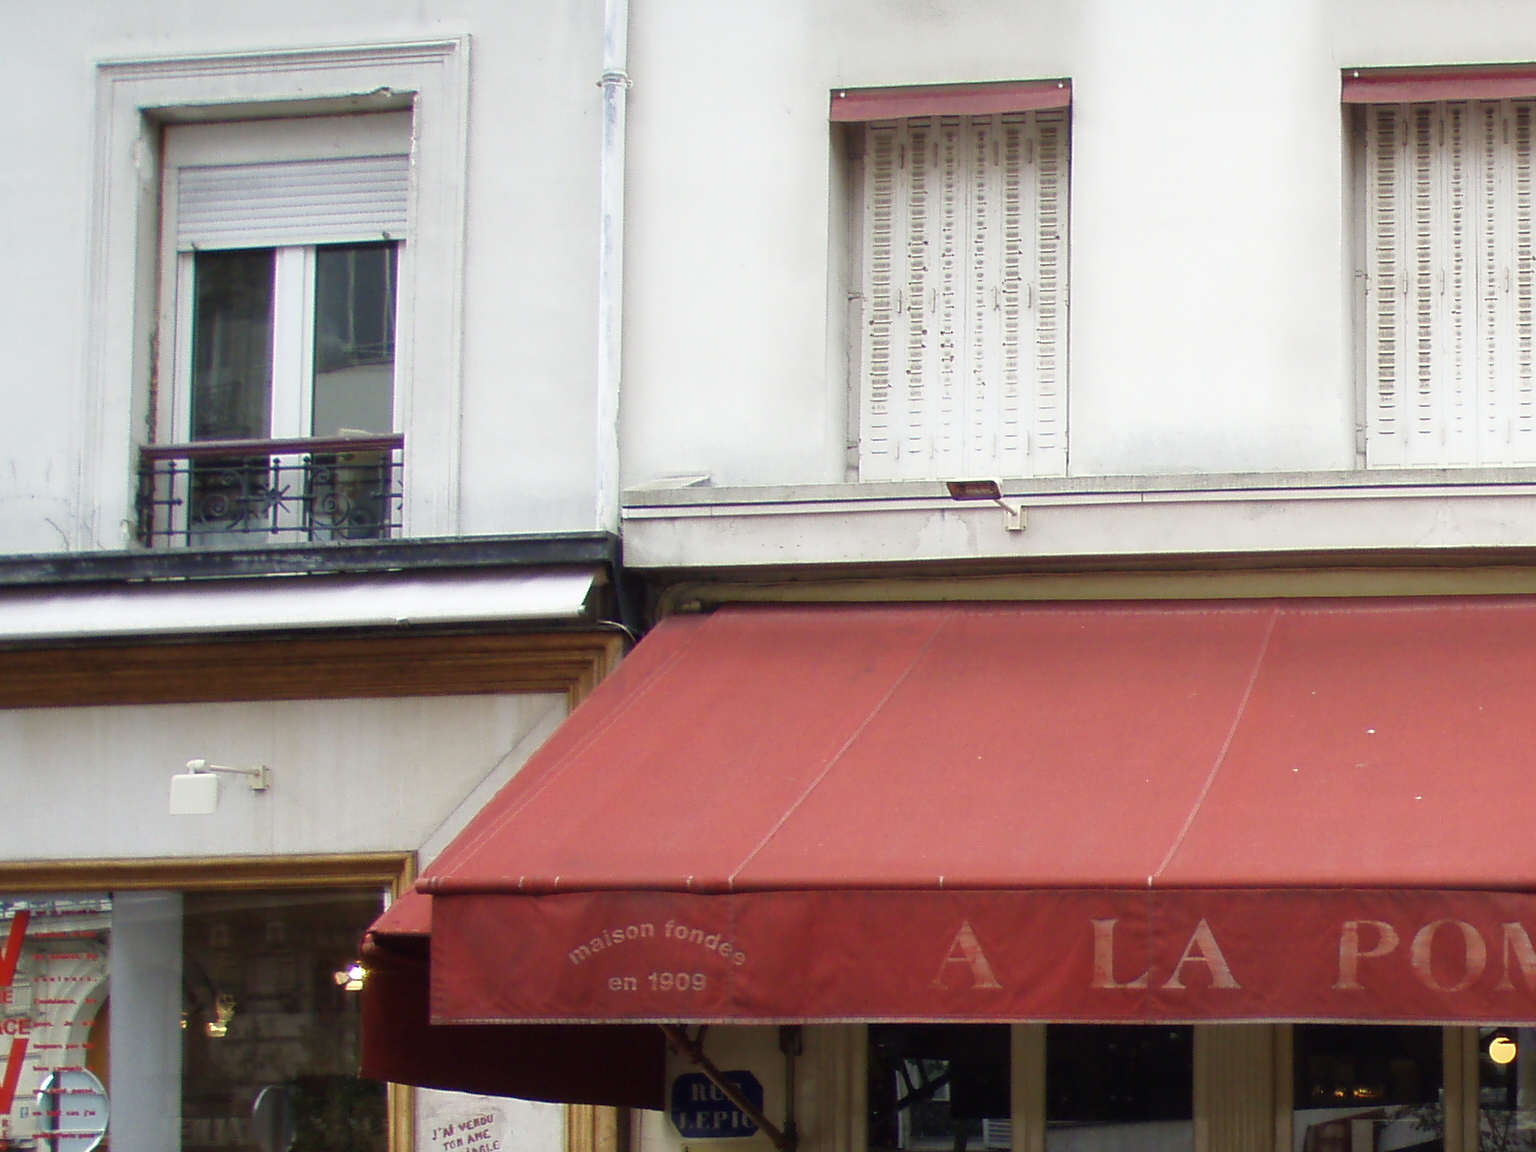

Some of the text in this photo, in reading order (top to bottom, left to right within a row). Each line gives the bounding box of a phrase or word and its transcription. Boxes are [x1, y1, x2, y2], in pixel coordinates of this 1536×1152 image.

[568, 922, 655, 965] maison
[931, 919, 1002, 990] A
[1090, 917, 1242, 990] LA
[608, 971, 707, 991] en 1909
[458, 1114, 494, 1132] VENDU
[467, 1128, 491, 1145] AME
